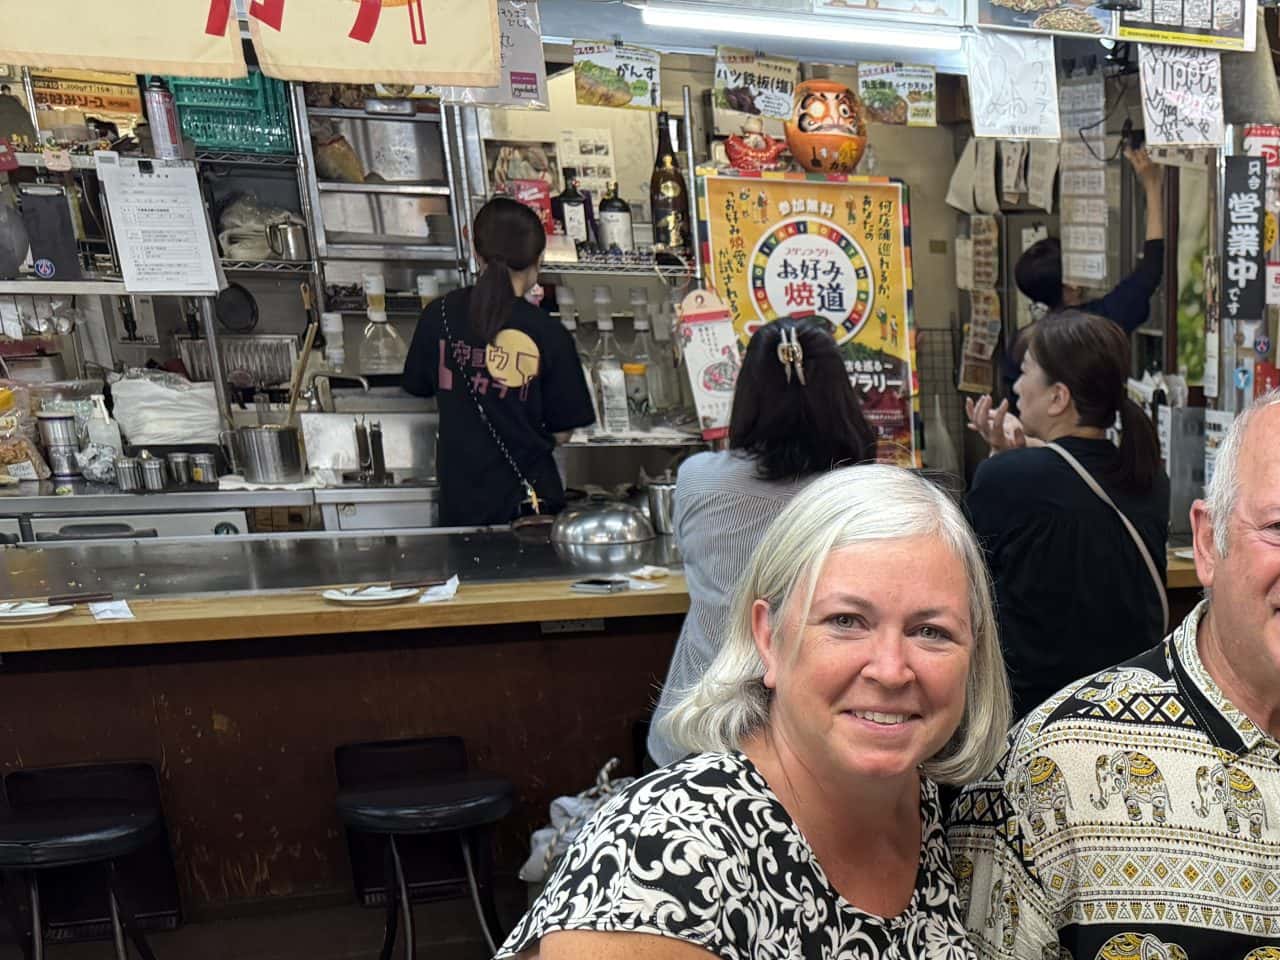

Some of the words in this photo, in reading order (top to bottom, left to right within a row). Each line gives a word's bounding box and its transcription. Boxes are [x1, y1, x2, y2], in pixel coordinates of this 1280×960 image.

[616, 63, 657, 79] がんす
[716, 67, 795, 96] ハツ鉄板(塩)
[777, 199, 835, 218] 参加無料
[1226, 191, 1262, 288] 営業中
[777, 259, 844, 282] お好み
[784, 282, 847, 314] 焼道
